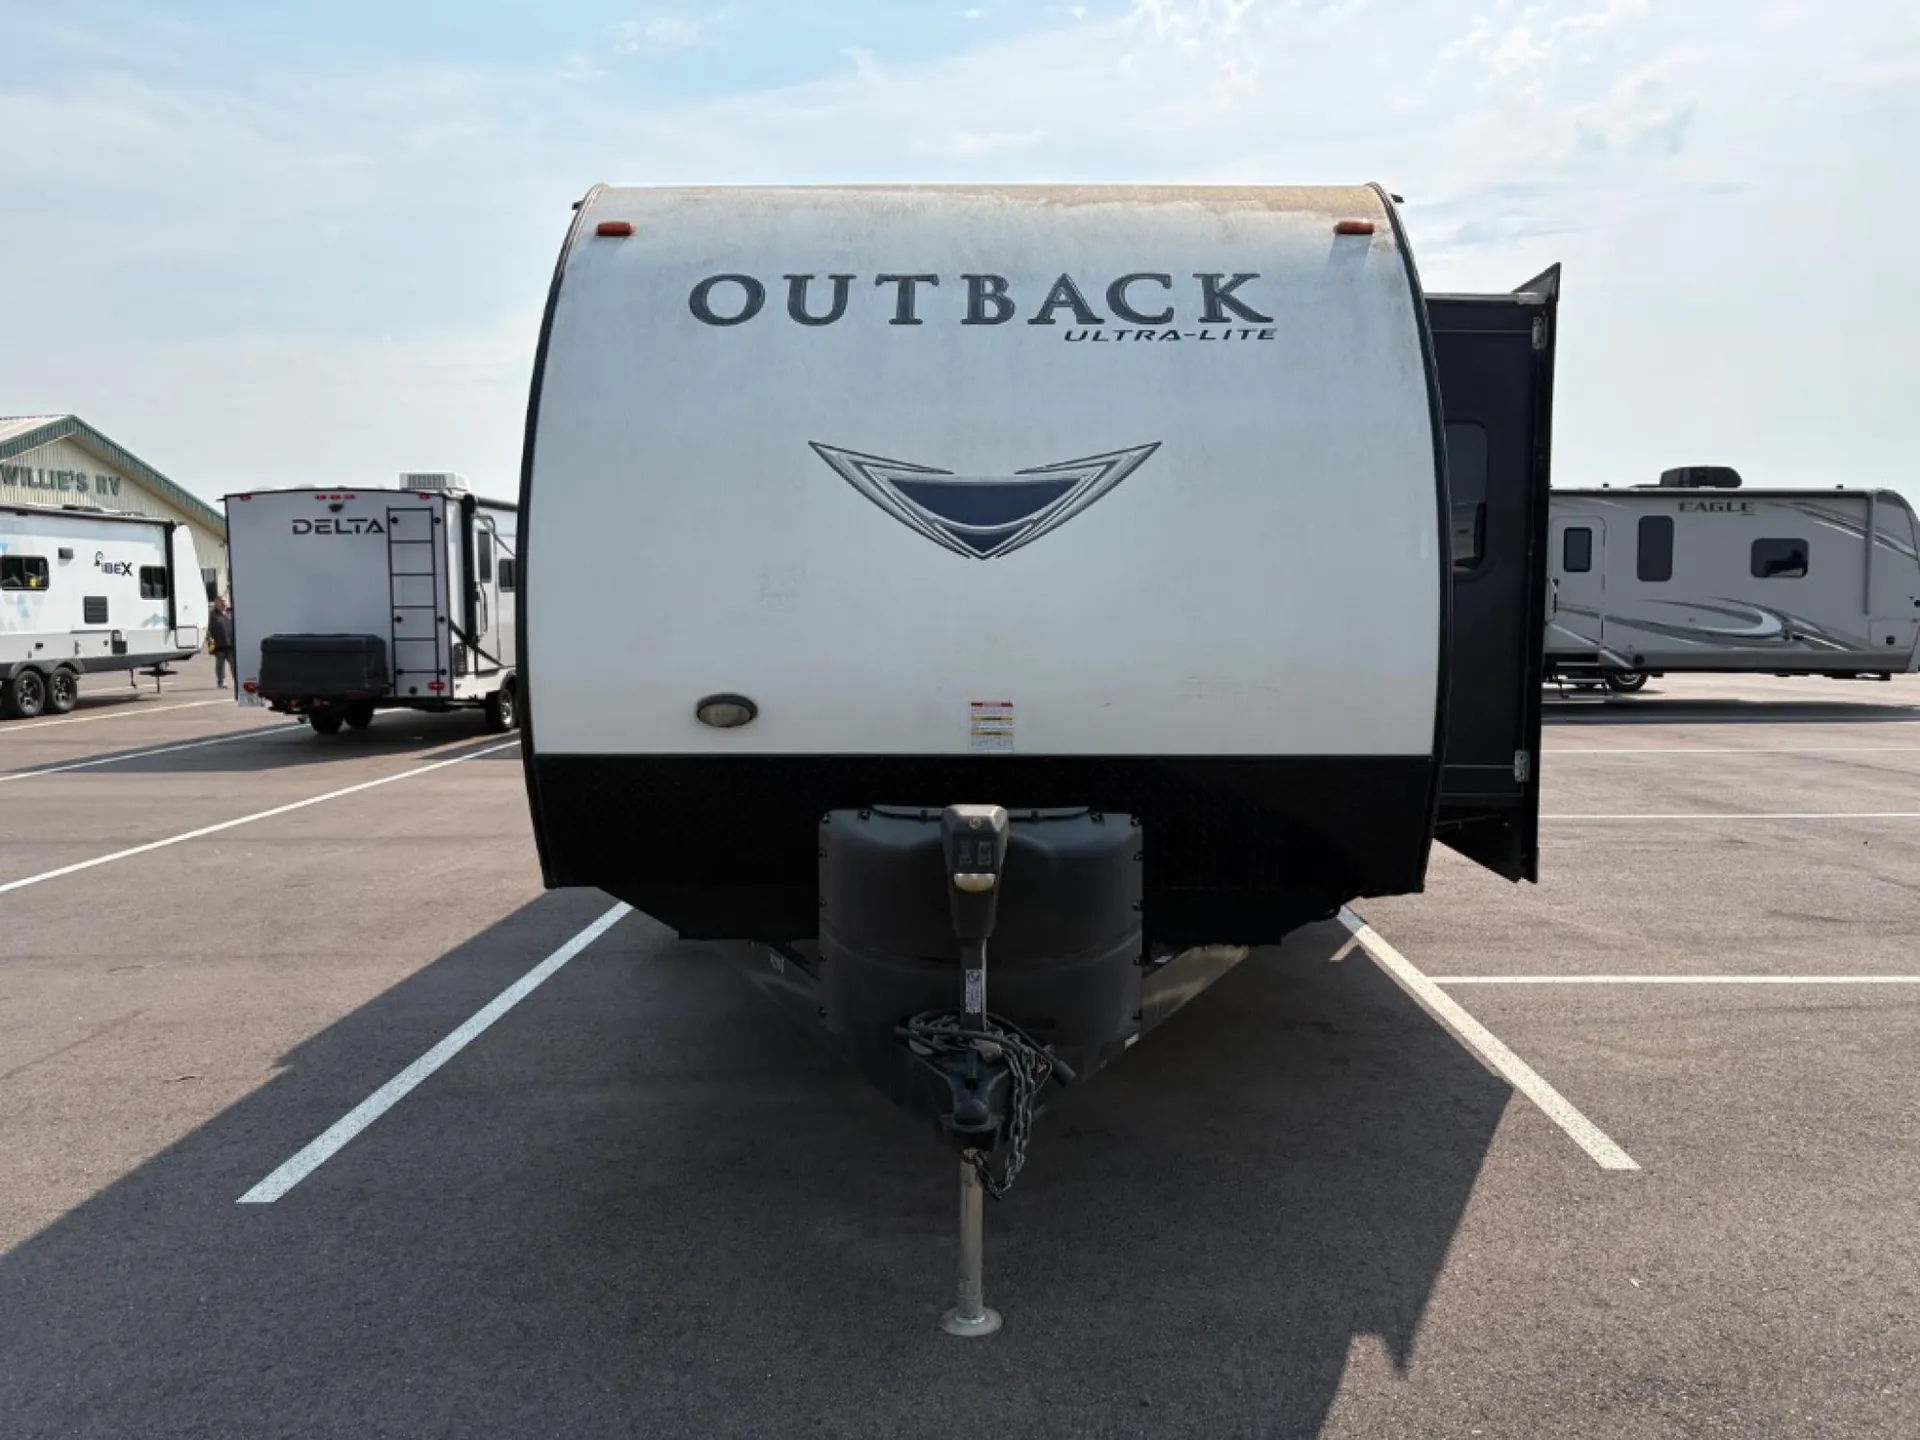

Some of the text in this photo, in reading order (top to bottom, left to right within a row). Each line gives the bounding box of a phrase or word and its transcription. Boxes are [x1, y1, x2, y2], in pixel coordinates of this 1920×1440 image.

[688, 272, 1275, 327] OUTBACK
[1064, 328, 1277, 342] ULTRA-LITE
[0, 464, 121, 496] WILLIE'S RV
[1679, 501, 1756, 513] EAGLE
[292, 518, 385, 535] DELTA
